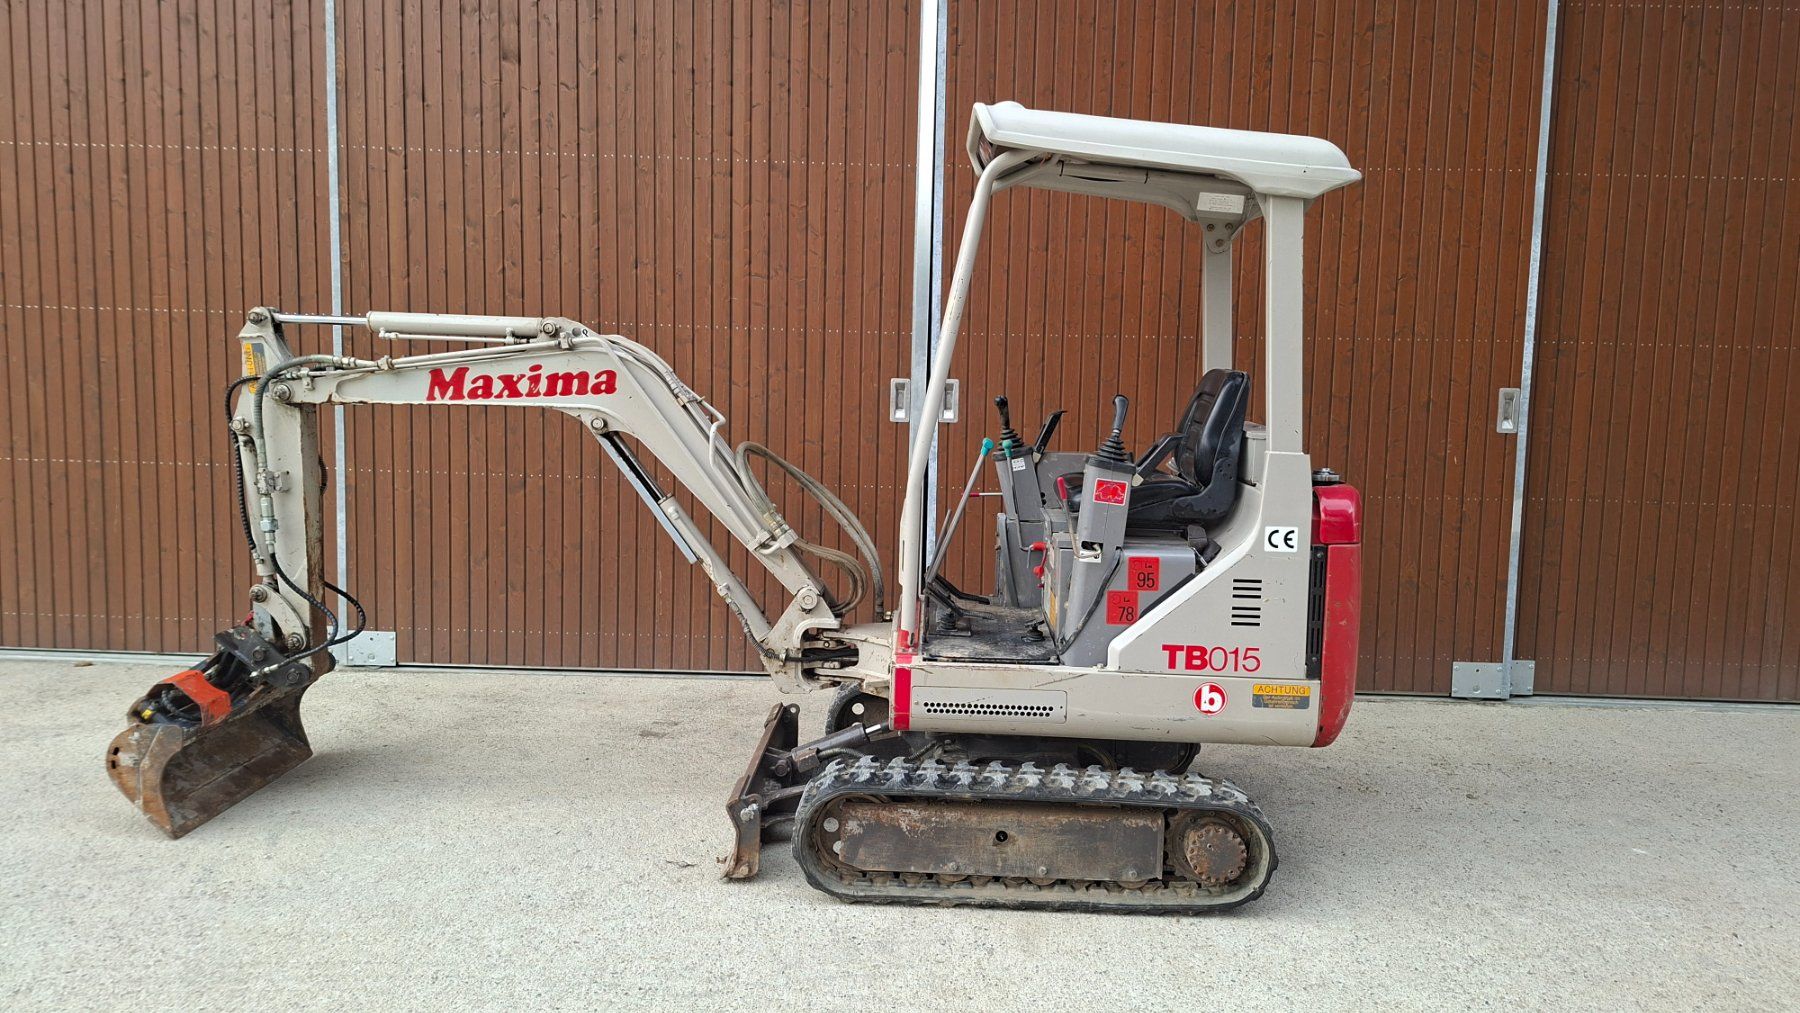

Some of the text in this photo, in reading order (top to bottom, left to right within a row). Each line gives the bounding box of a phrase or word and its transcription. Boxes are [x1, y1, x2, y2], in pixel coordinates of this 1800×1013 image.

[426, 364, 618, 401] Maxima
[1268, 530, 1295, 549] CE
[1136, 571, 1155, 588] 95
[1118, 606, 1134, 622] 78
[1161, 644, 1261, 672] TB015
[1257, 685, 1306, 695] ACHTUNG
